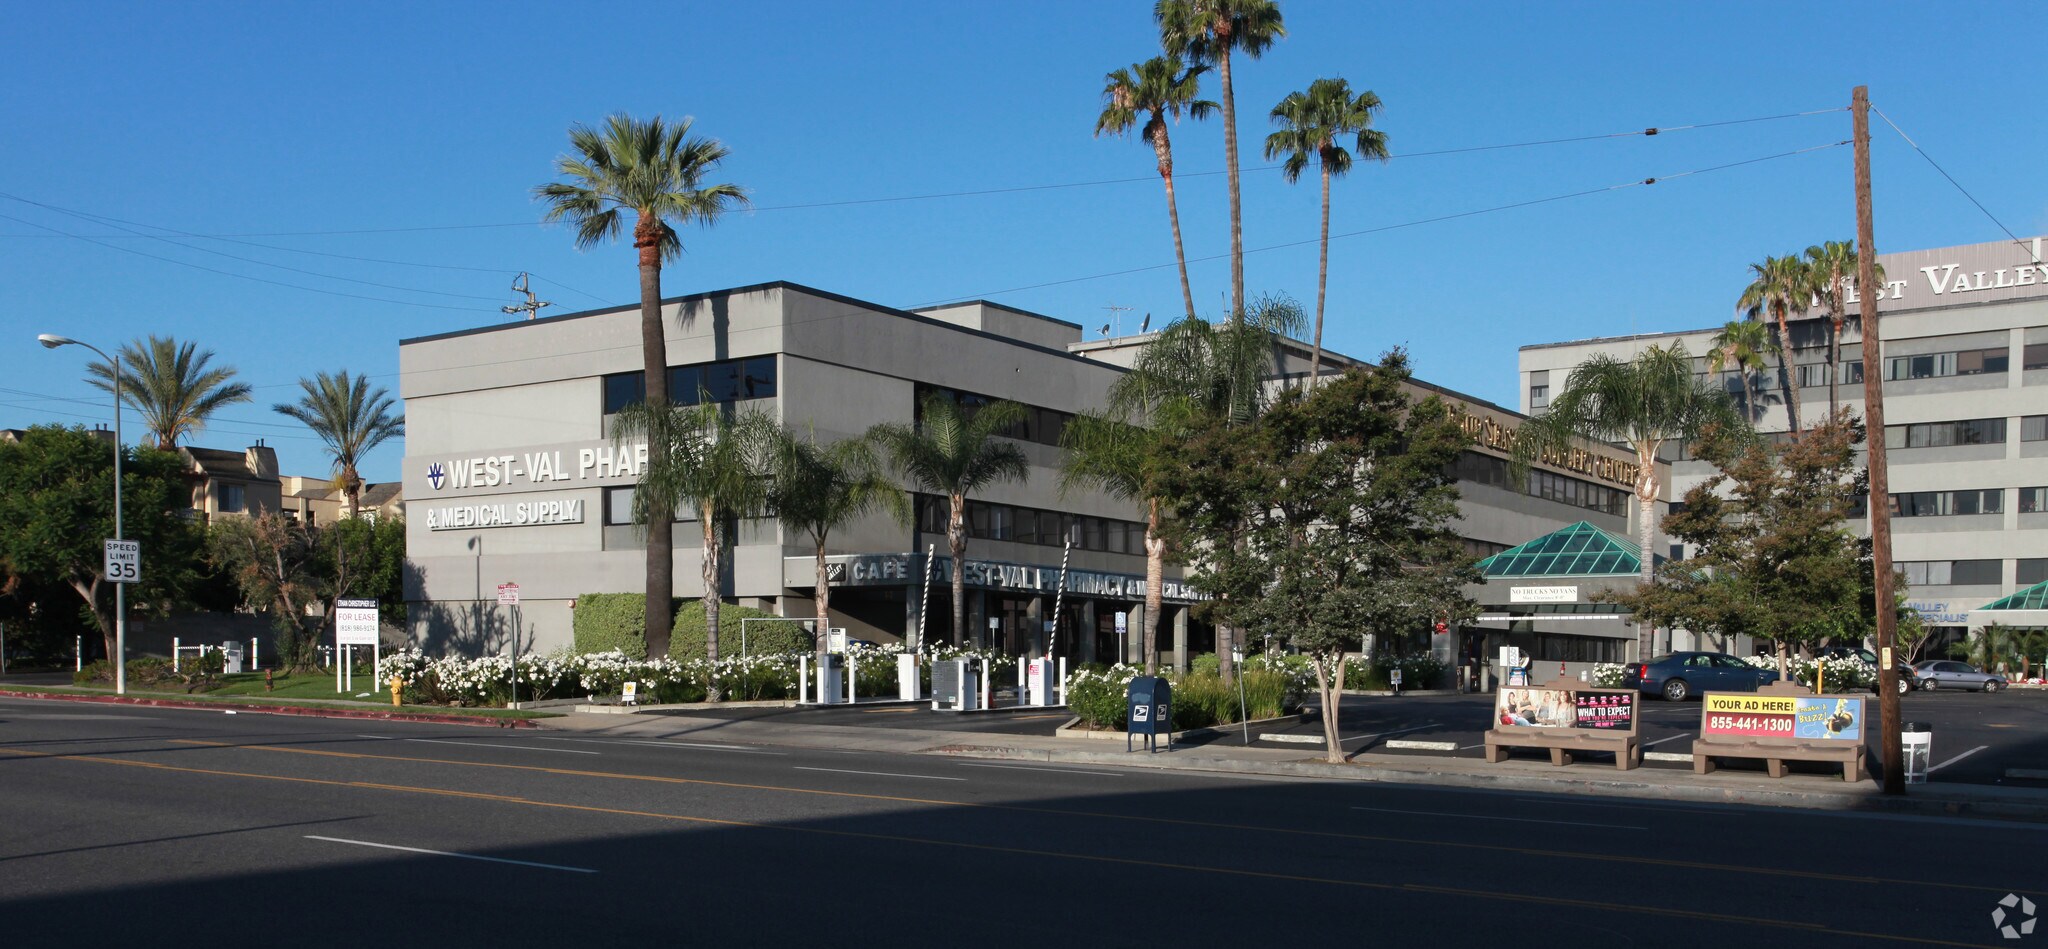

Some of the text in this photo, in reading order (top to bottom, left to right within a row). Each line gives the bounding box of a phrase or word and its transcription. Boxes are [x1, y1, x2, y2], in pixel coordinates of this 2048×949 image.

[1920, 263, 2048, 294] VALLEY
[448, 451, 570, 489] WEST-VAL
[427, 499, 577, 528] & MEDICAL SUPPLY
[107, 543, 138, 551] SPEED
[110, 562, 136, 578] 35
[853, 562, 909, 580] CAFE
[1036, 568, 1126, 596] PHARMACY
[1127, 579, 1136, 595] &
[1908, 602, 1949, 613] VALLEY
[339, 613, 375, 621] FOR LEASE
[1578, 706, 1630, 716] WHAT TO EXPECT
[1712, 699, 1794, 712] YOUR AD HERE!
[1711, 716, 1792, 732] 855-441-1300
